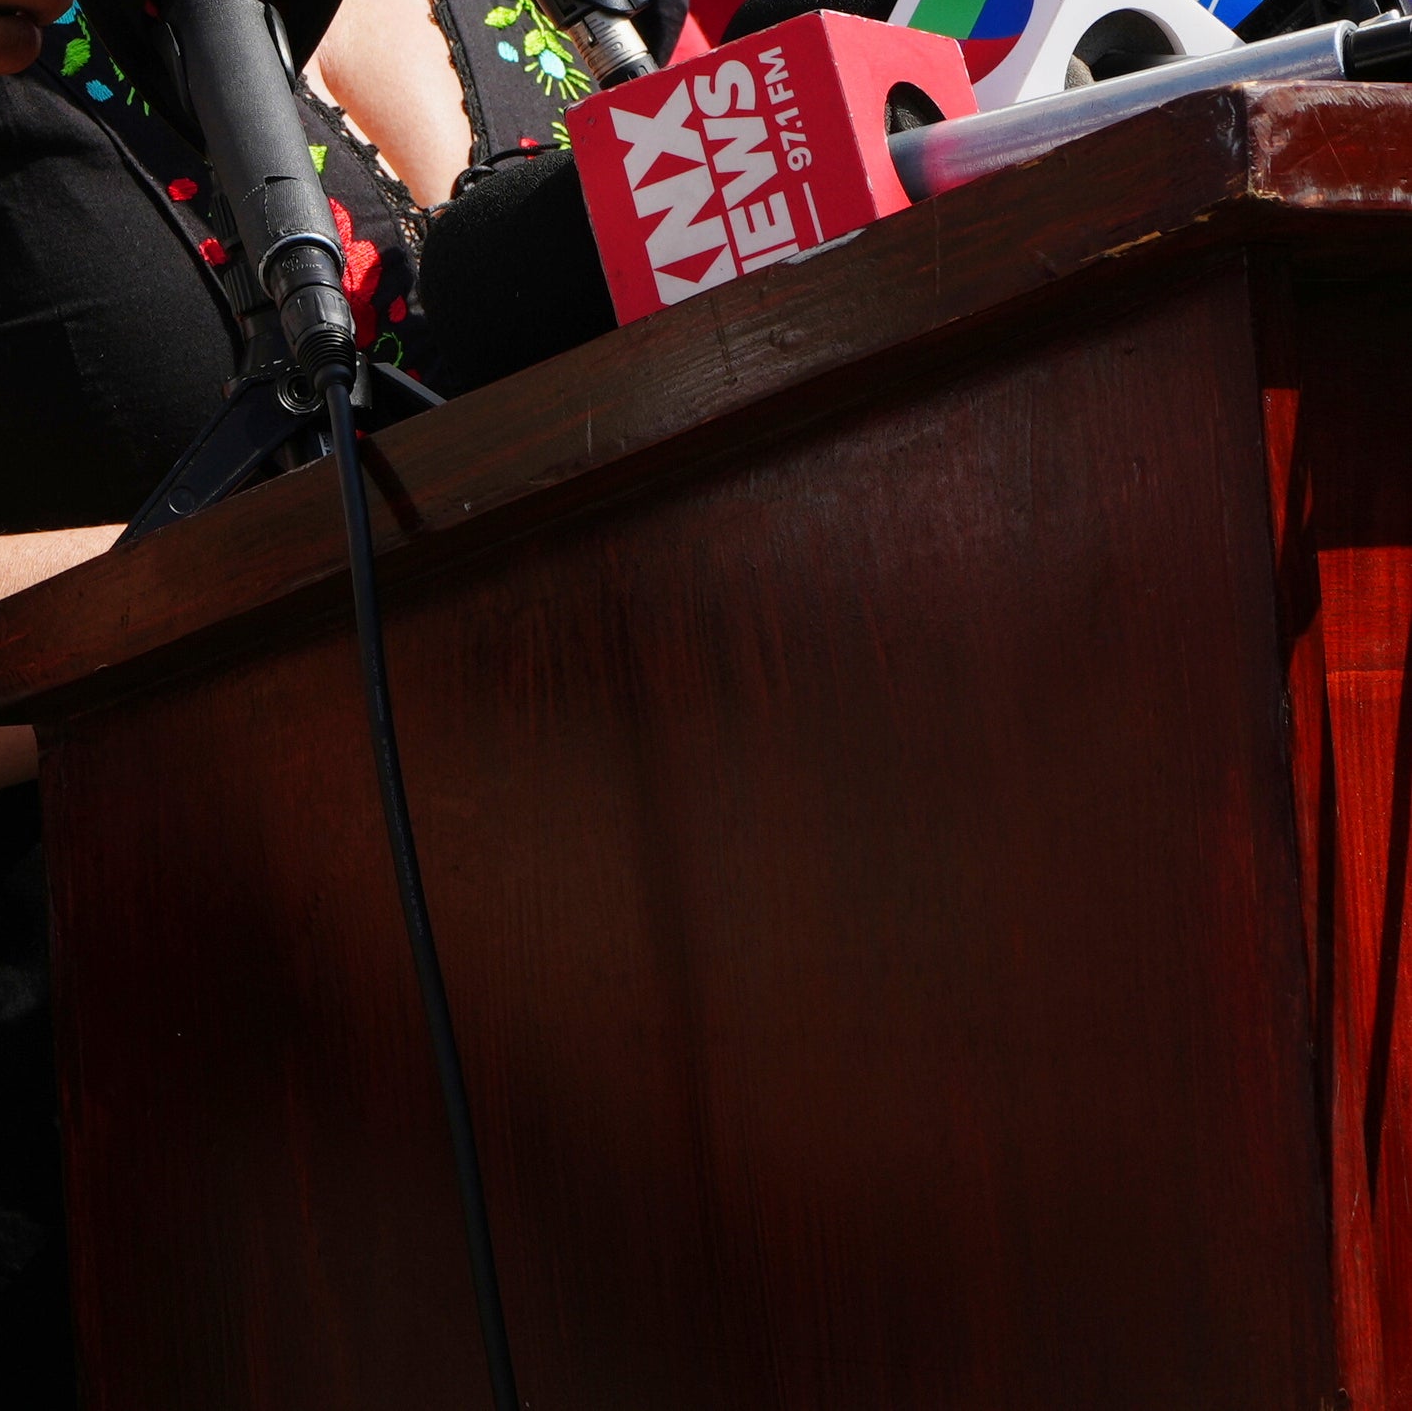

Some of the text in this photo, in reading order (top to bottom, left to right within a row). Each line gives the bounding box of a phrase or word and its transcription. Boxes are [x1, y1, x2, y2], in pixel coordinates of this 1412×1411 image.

[609, 78, 739, 306] KNX
[757, 46, 813, 172] 97.1 FM
